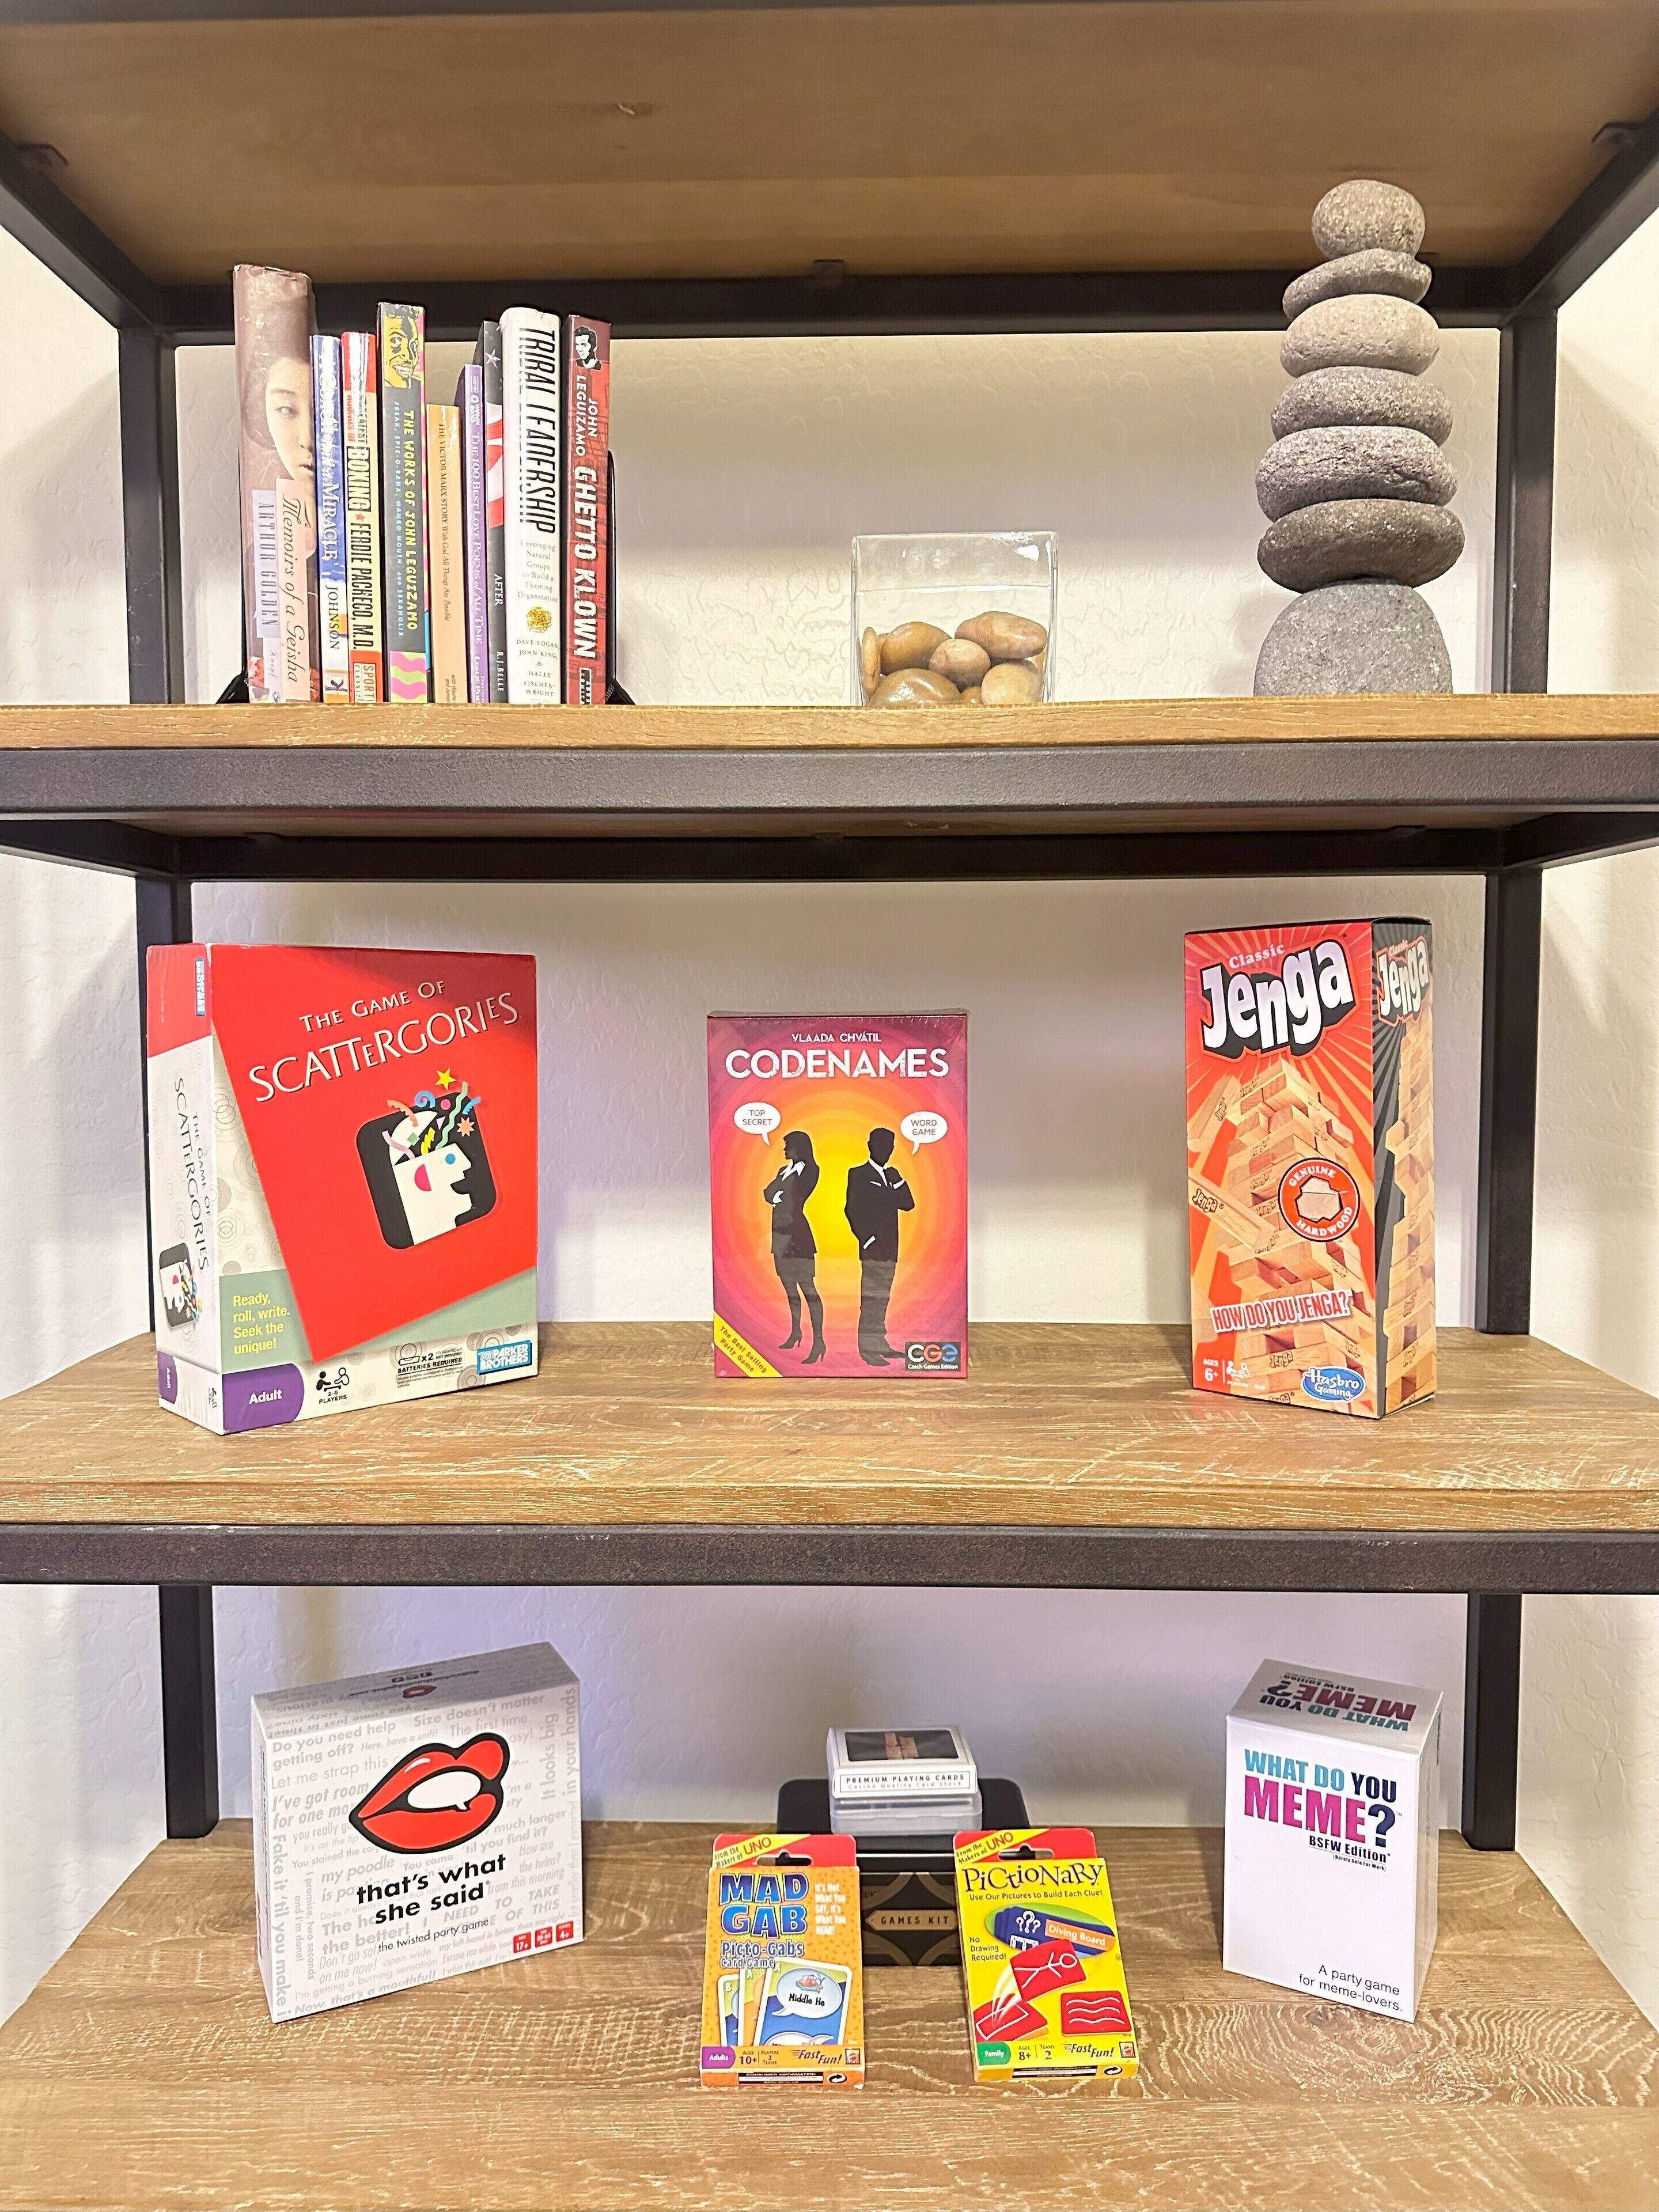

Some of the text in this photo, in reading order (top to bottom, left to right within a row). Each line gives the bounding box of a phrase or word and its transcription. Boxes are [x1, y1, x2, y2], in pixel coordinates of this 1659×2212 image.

[576, 375, 586, 457] LEGUIZAMO
[588, 397, 598, 437] JOHN
[348, 448, 370, 510] BOXING
[520, 403, 556, 534] LEADERSHIP
[322, 482, 340, 560] MIRACLE
[403, 411, 418, 630] THE WORKS OF JOHN LEGUIZAMO
[573, 465, 597, 560] GHETTO
[259, 502, 279, 626] ARTHUR GOLDEN
[279, 493, 307, 683] Memoirs of Geisha
[350, 523, 374, 649] FERDIE PACHECO, M.D.
[472, 510, 484, 645] LOVE POEMS TIME
[494, 574, 503, 606] AFTER
[326, 585, 340, 650] JOHNSON
[573, 567, 597, 659] KLOWN
[363, 665, 375, 699] SPORT
[525, 689, 554, 697] WRIGHT
[1229, 944, 1286, 969] Classic
[1378, 941, 1429, 1017] Jenga
[299, 979, 446, 1033] THE GAME OF
[1201, 940, 1355, 1050] Jenga
[248, 991, 520, 1103] SCATTERGORIES
[791, 1031, 882, 1043] VLAADA CHVÁTIL
[725, 1047, 950, 1079] CODENAMES
[743, 1118, 773, 1126] SECRET
[749, 1109, 766, 1117] TOP
[910, 1119, 938, 1127] WORD
[912, 1128, 937, 1136] GAME
[175, 1078, 209, 1271] SCATTERGORIES
[1289, 1165, 1336, 1188] GENUINE
[1192, 1188, 1217, 1213] Jenga
[1296, 1206, 1353, 1237] HARDWOOD
[233, 1292, 271, 1307] Ready,
[1212, 1290, 1349, 1332] HOW DO YOU JENGA?
[233, 1306, 290, 1323] roll, write.
[234, 1322, 284, 1338] Seek the
[234, 1338, 276, 1355] unique!
[491, 1344, 529, 1359] PARKER
[719, 1325, 768, 1374] The Best Selling
[719, 1338, 755, 1373] Party Game
[397, 1357, 463, 1374] BATTERIES REQUIRED
[480, 1354, 529, 1372] BROTHERS
[1269, 1351, 1294, 1368] Jenga
[1205, 1368, 1218, 1382] 6+
[1304, 1369, 1360, 1389] Hasbro
[248, 1388, 282, 1405] Adult
[319, 1395, 347, 1404] PLAYERS
[1315, 1381, 1353, 1400] Gaming
[1259, 1695, 1409, 1732] WHAT DO YOU
[272, 1720, 396, 1753] Do you need help
[272, 1750, 323, 1772] getting
[846, 1776, 888, 1784] PREMIUM
[1244, 1748, 1397, 1803] WHAT DO YOU
[305, 1782, 369, 1806] got room
[1244, 1774, 1396, 1849] MEME?
[743, 1836, 771, 1855] UNO
[986, 1832, 1014, 1850] UNO
[1309, 1835, 1342, 1852] BSFW
[357, 1854, 506, 1904] that's what
[719, 1872, 809, 1906] MAD
[375, 1882, 484, 1924] she said
[1002, 1892, 1032, 1900] Pictures
[1044, 1890, 1062, 1898] Build
[721, 1904, 808, 1939] GAB
[881, 1915, 950, 1925] GAMES KIT
[378, 1919, 488, 1953] the twisted party game
[1049, 1924, 1106, 1946] Diving Board
[721, 1940, 804, 1957] Picto-Gabs
[971, 1944, 999, 1953] Drawing
[972, 1953, 1006, 1961] Required!
[720, 1956, 775, 1969] Card Game
[1319, 1964, 1400, 1996] A party game
[789, 1993, 812, 2005] Middle
[1299, 1974, 1404, 2012] for meme-lovers.
[740, 2056, 757, 2065] 10+
[798, 2050, 842, 2065] Fast Fun!
[985, 2050, 1005, 2058] Family
[1018, 2051, 1031, 2060] 8+
[1071, 2043, 1115, 2058] Fast Fun!
